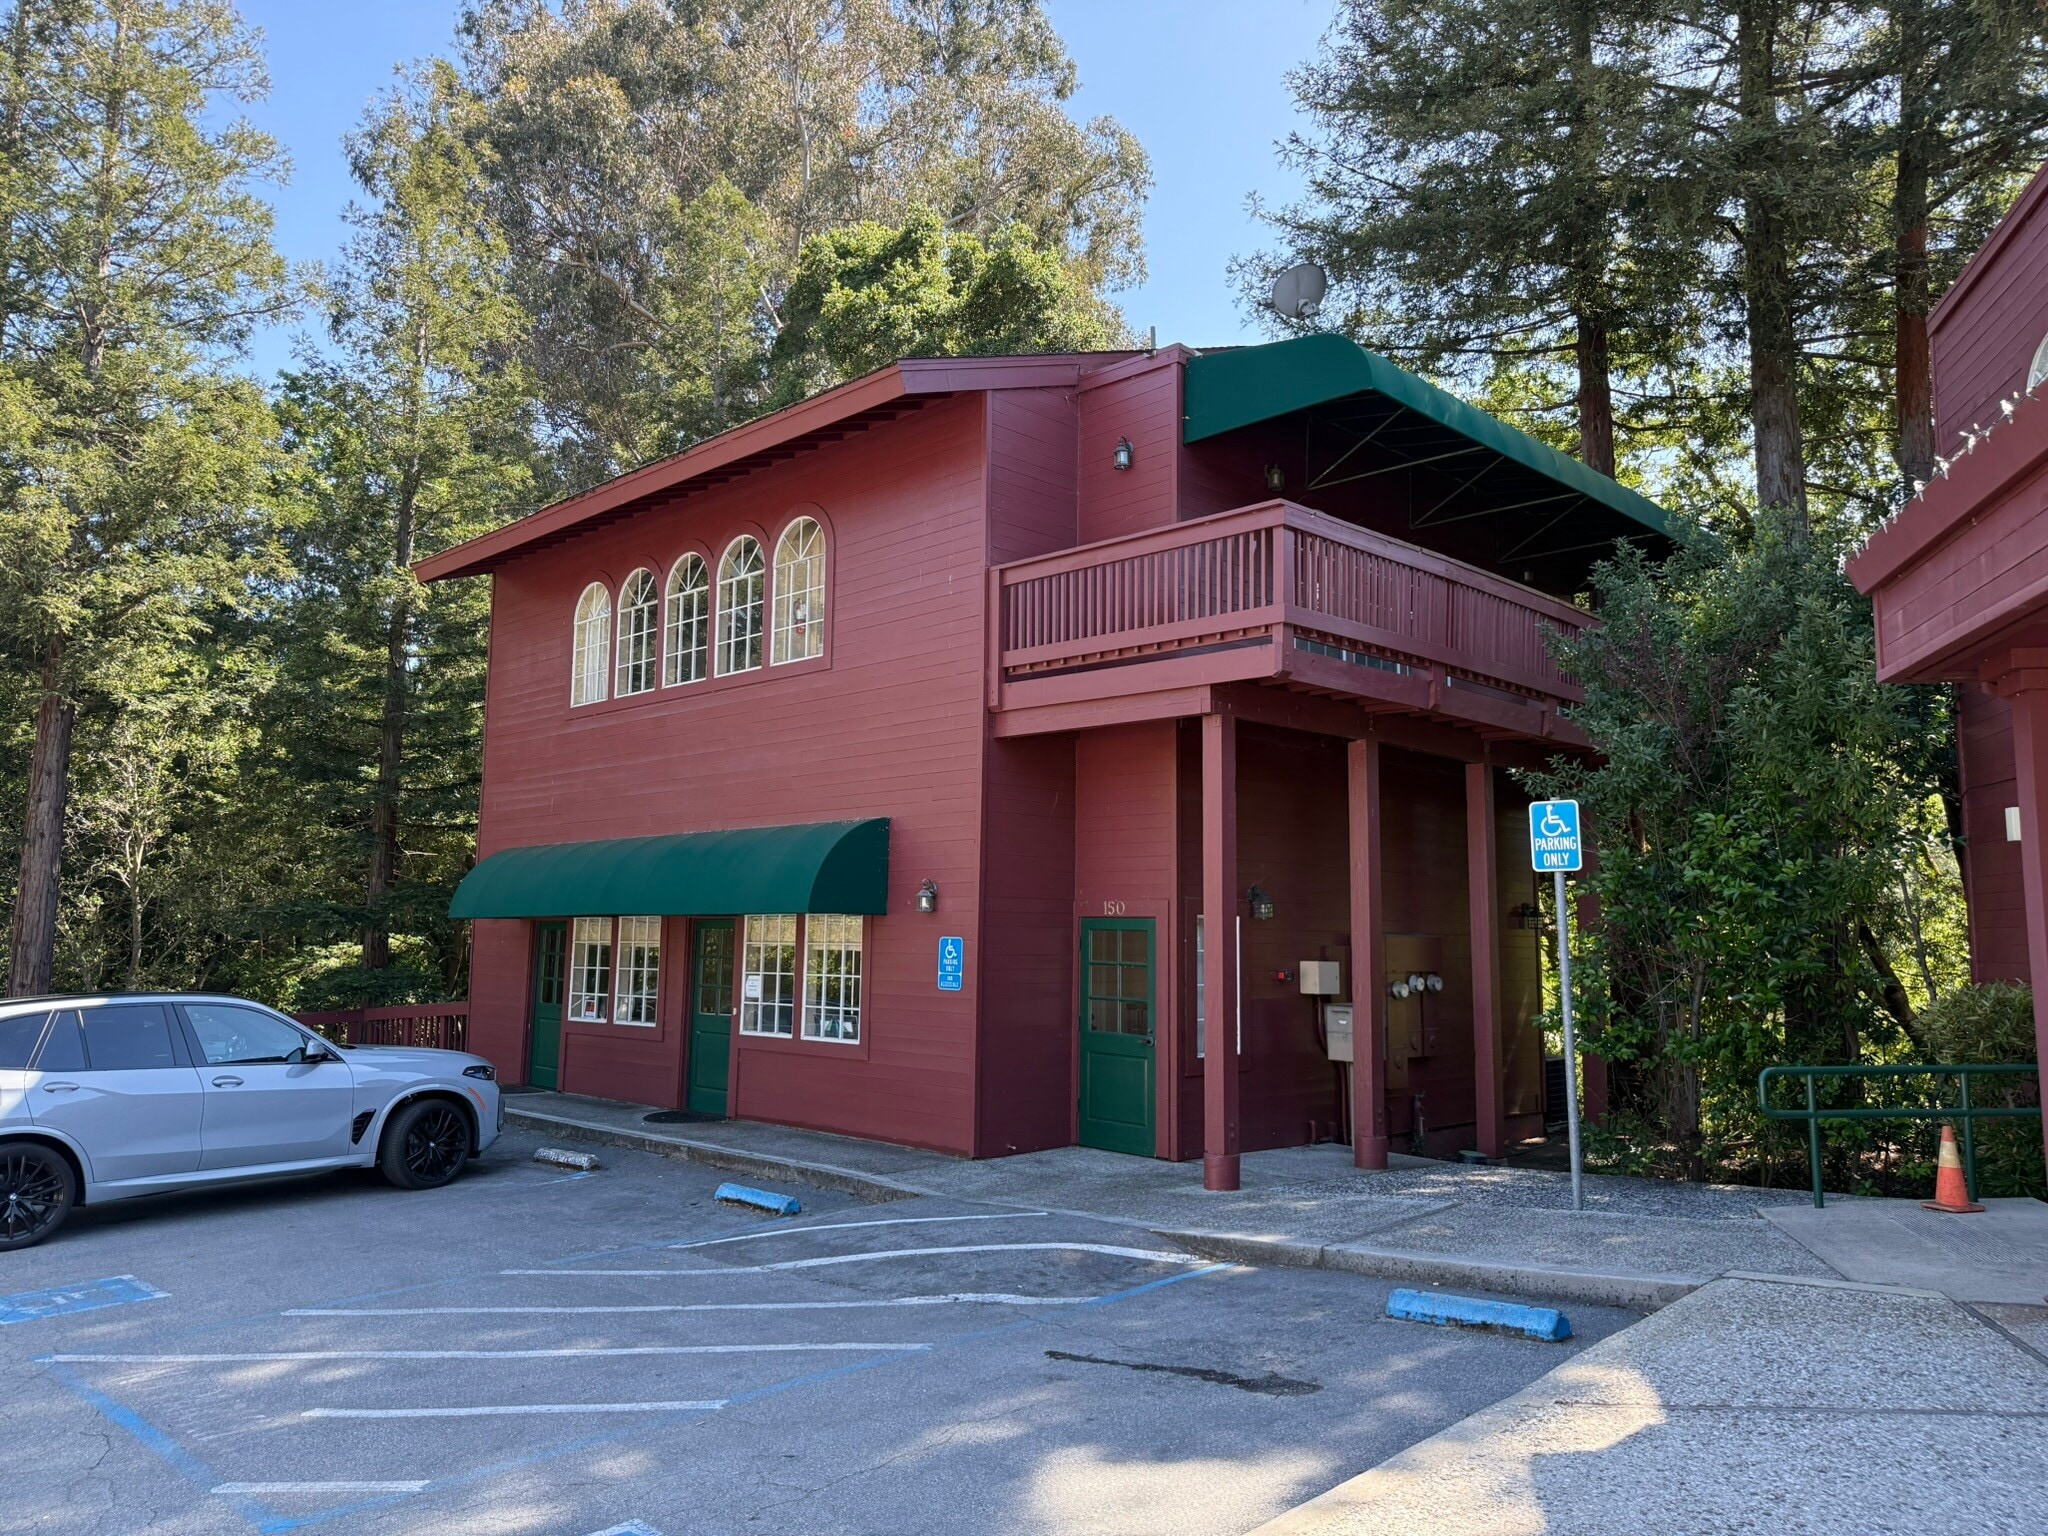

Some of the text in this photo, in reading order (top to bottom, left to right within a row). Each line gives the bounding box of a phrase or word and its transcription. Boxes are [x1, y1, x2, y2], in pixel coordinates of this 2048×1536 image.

[1535, 837, 1577, 851] PARKING
[1543, 853, 1569, 866] ONLY
[1104, 901, 1125, 915] 150
